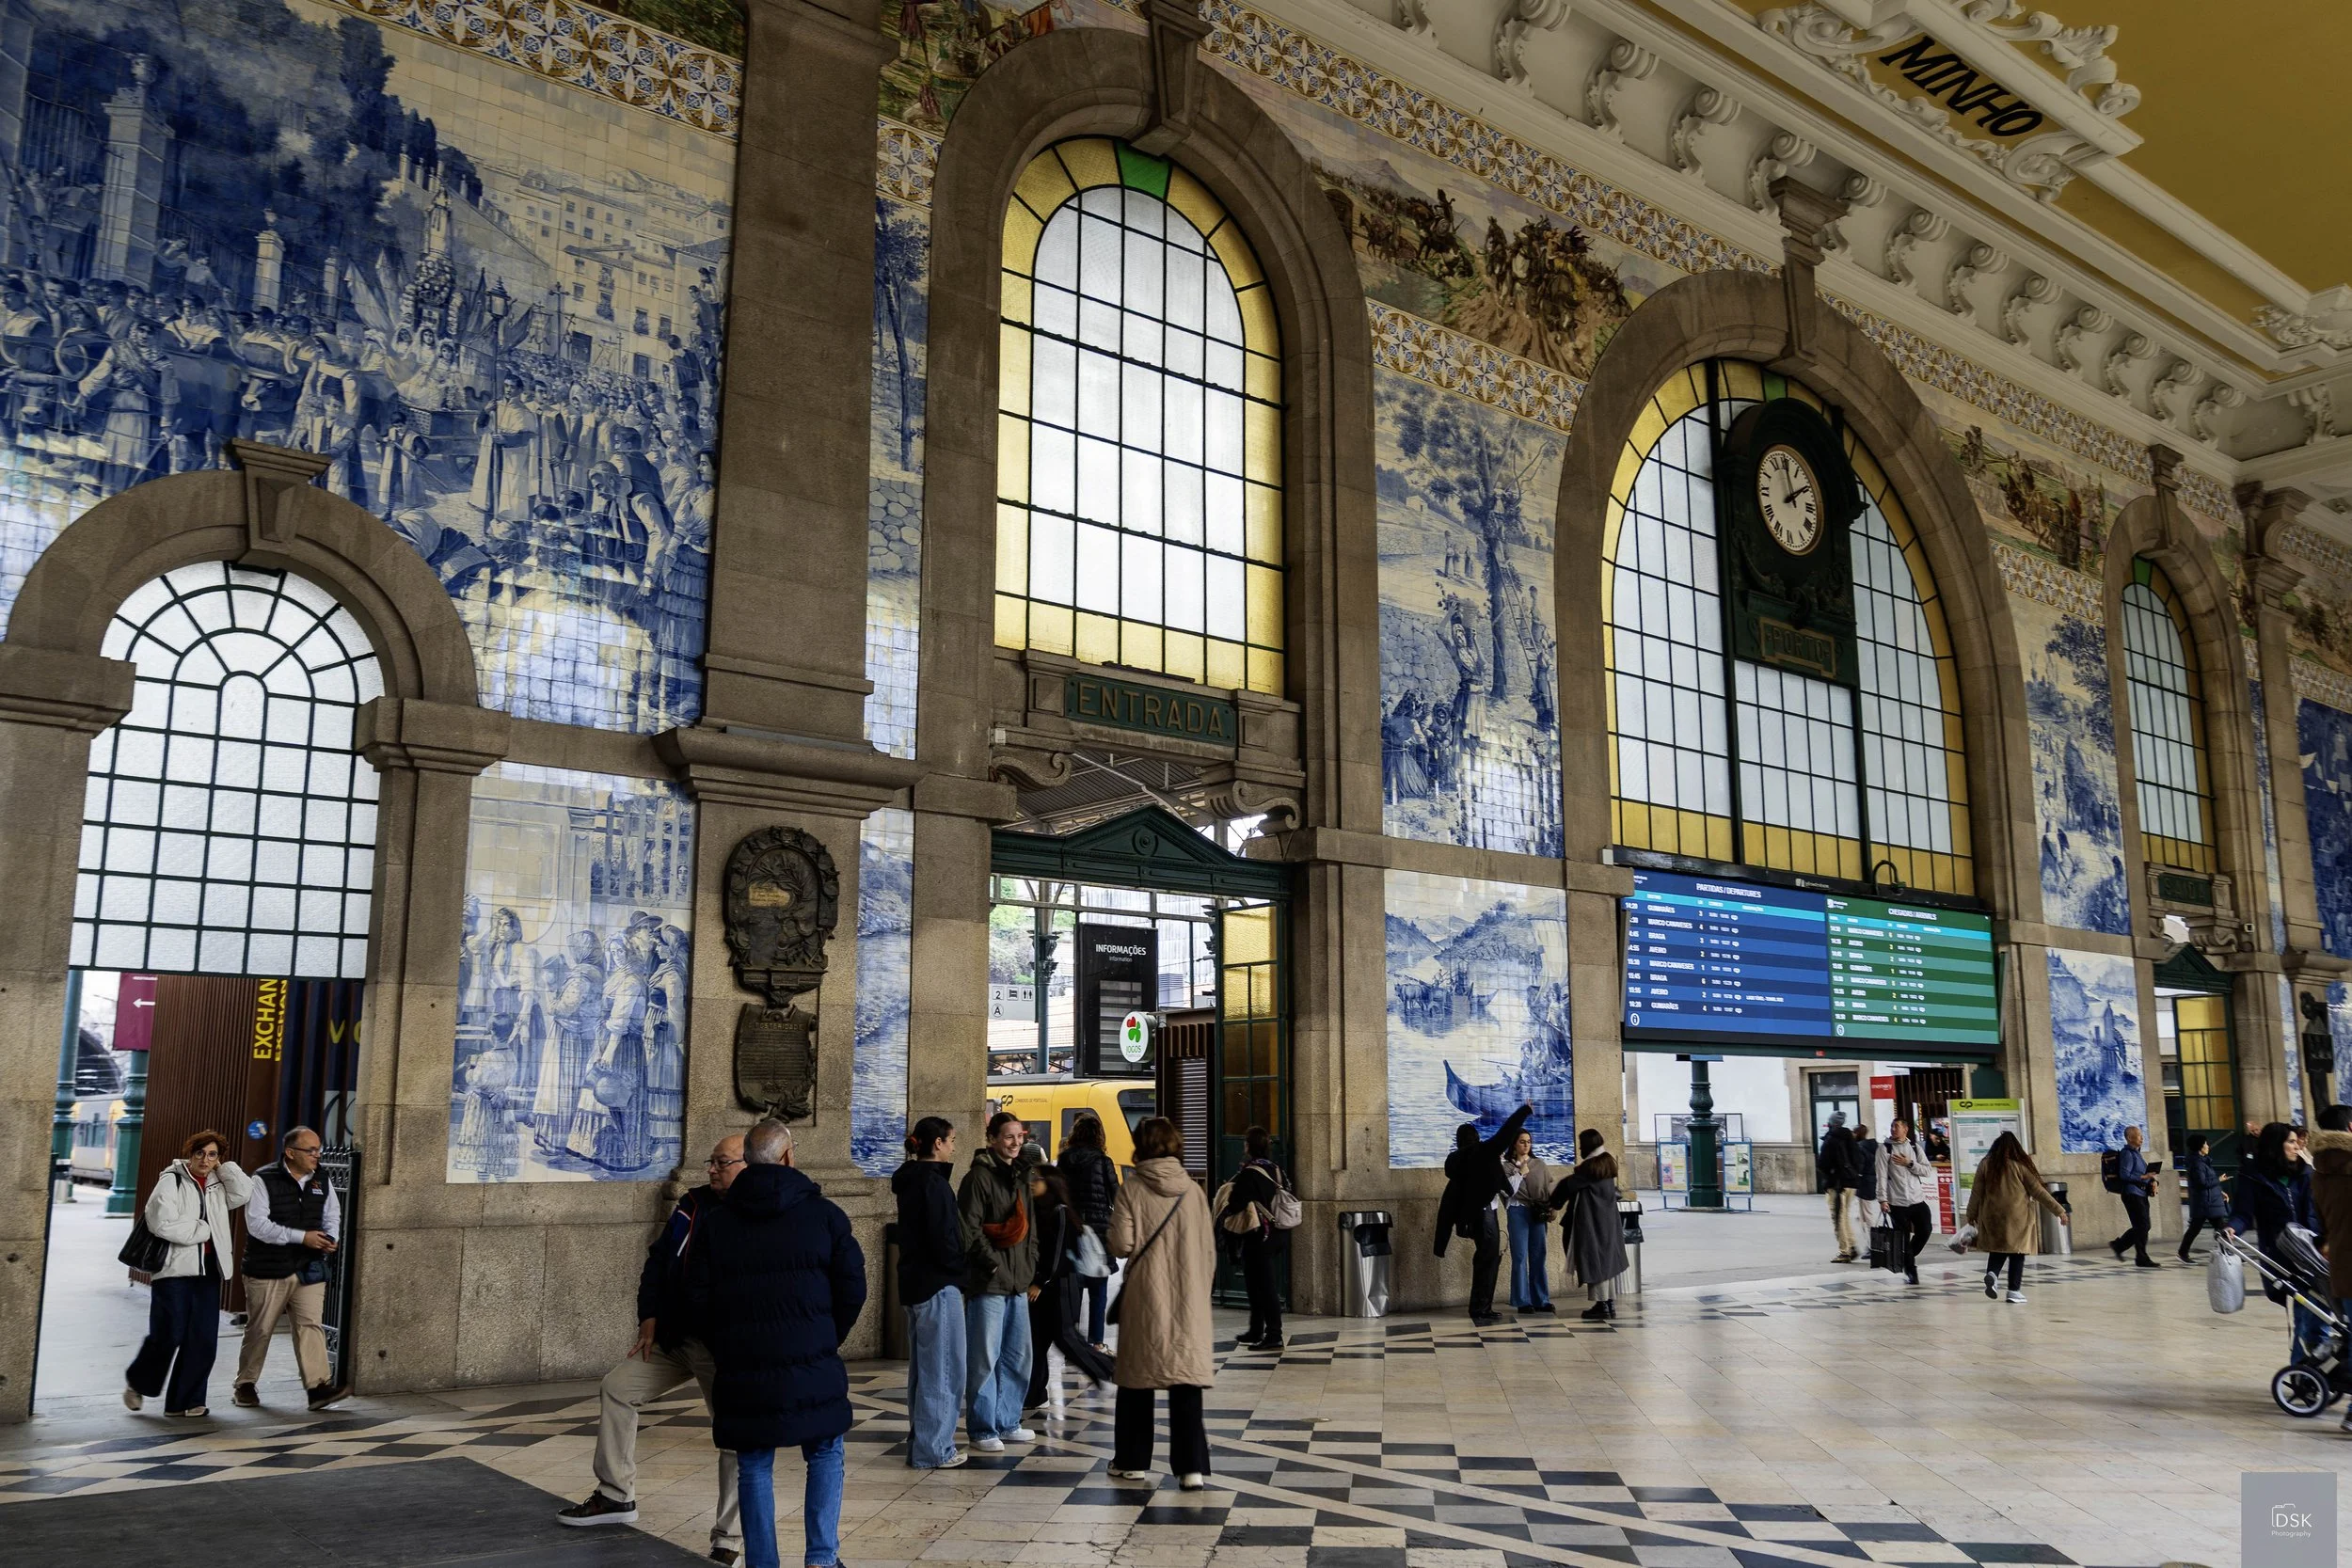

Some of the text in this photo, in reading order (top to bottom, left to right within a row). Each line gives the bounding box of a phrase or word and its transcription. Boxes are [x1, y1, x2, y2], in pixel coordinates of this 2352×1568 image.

[1879, 35, 2043, 137] MINHO
[1772, 627, 1823, 662] PORTO
[1077, 681, 1224, 737] ENTRADA
[1695, 882, 1724, 894] PARTIDAS
[1726, 887, 1762, 898] DEPARTURES
[1095, 943, 1147, 957] INFORMAÇÕES
[995, 990, 1001, 1000] 2
[993, 1006, 1002, 1016] A
[1125, 1045, 1142, 1054] JOGOS
